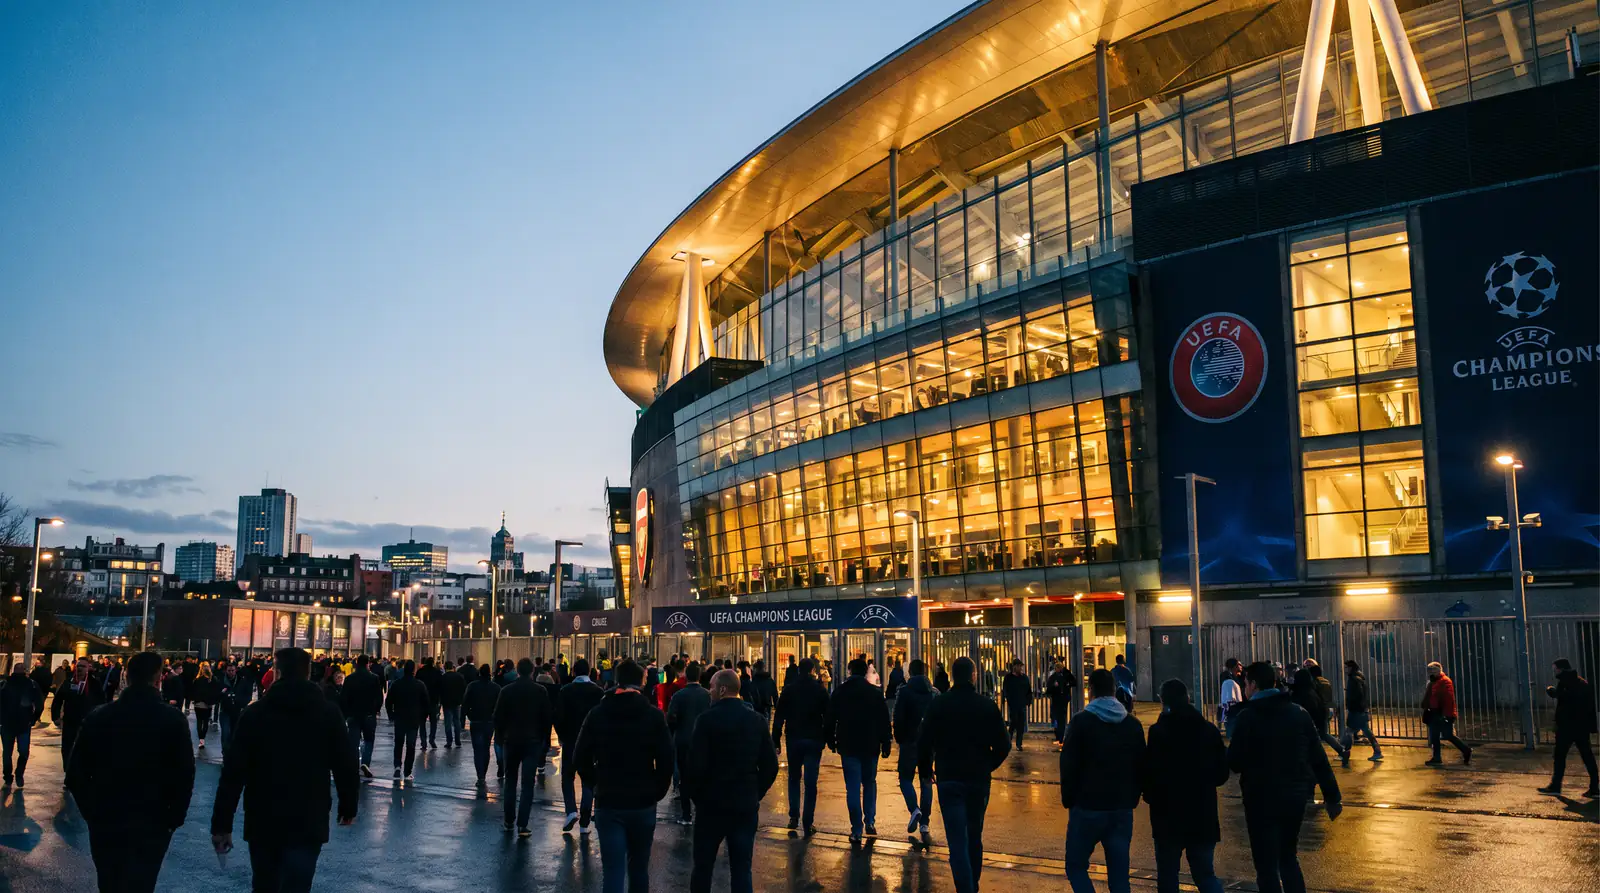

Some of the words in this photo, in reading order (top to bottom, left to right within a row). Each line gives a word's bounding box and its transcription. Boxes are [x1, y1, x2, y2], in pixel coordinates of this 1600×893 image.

[1186, 320, 1241, 347] UEFA
[1500, 329, 1550, 349] UEFA
[1492, 370, 1572, 391] LEAGUE
[668, 614, 689, 626] UEFA
[710, 612, 733, 624] UEFA
[734, 609, 790, 623] CHAMPIONS
[793, 608, 832, 622] LEAGUE
[861, 607, 889, 620] UEFA
